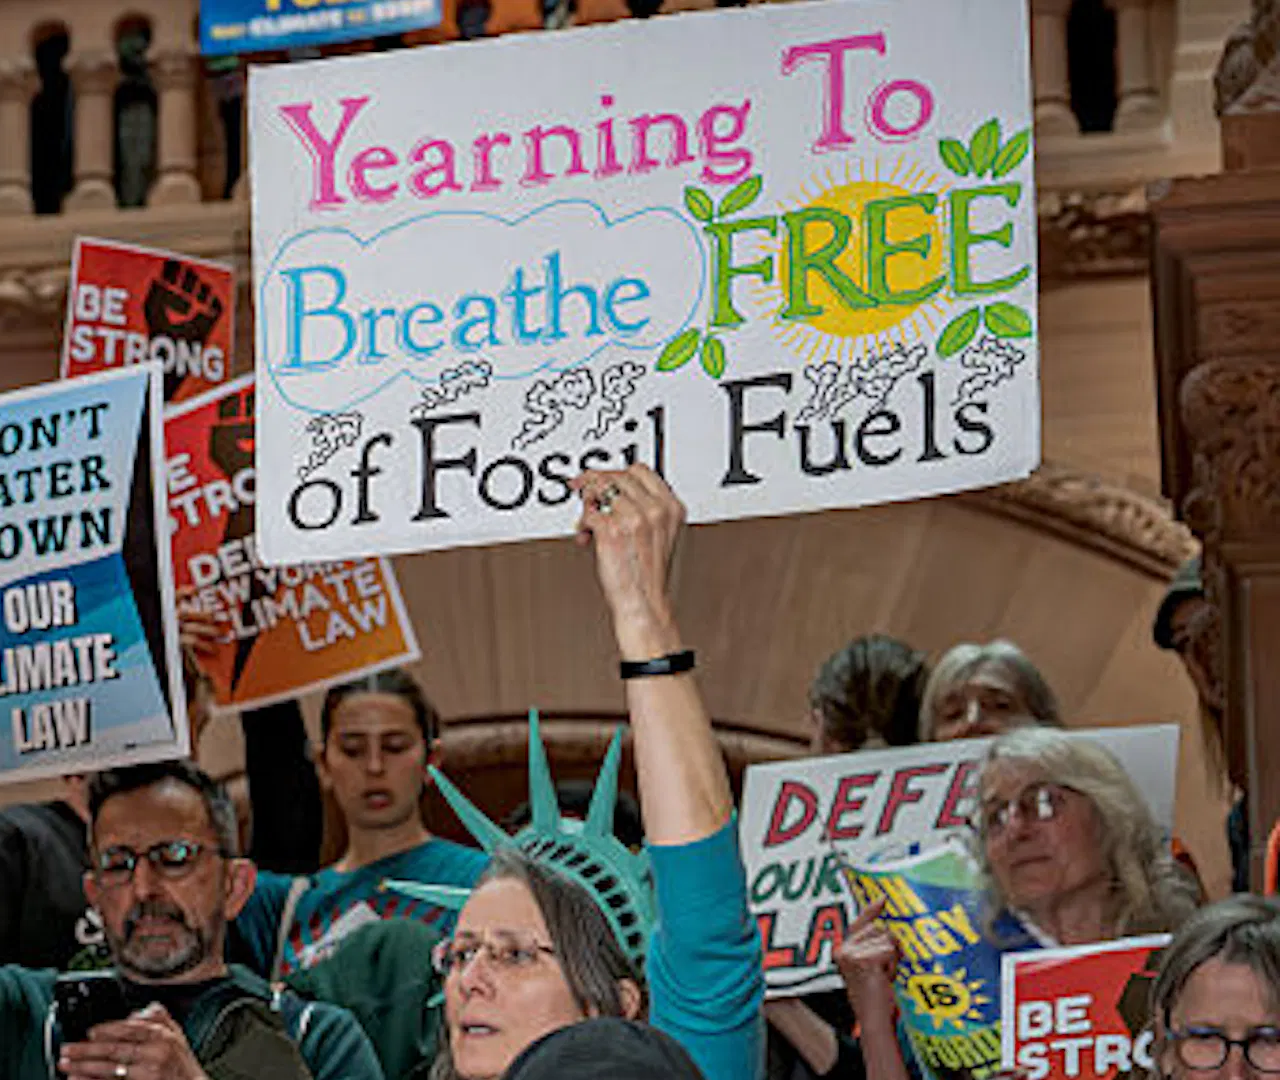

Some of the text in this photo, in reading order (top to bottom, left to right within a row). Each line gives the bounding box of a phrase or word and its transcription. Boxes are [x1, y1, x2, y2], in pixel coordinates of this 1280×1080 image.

[278, 32, 935, 213] Yearning To
[75, 284, 128, 325] BE
[278, 181, 1033, 374] Breathe FREE
[69, 328, 226, 384] STRONG
[286, 372, 997, 532] of Fossil Fuels
[3, 579, 77, 633] OUR
[298, 594, 387, 652] LAW
[12, 700, 94, 756] LAW
[751, 853, 848, 905] OUR
[758, 904, 850, 972] LA
[916, 982, 959, 1010] IS
[1017, 993, 1094, 1041] BE
